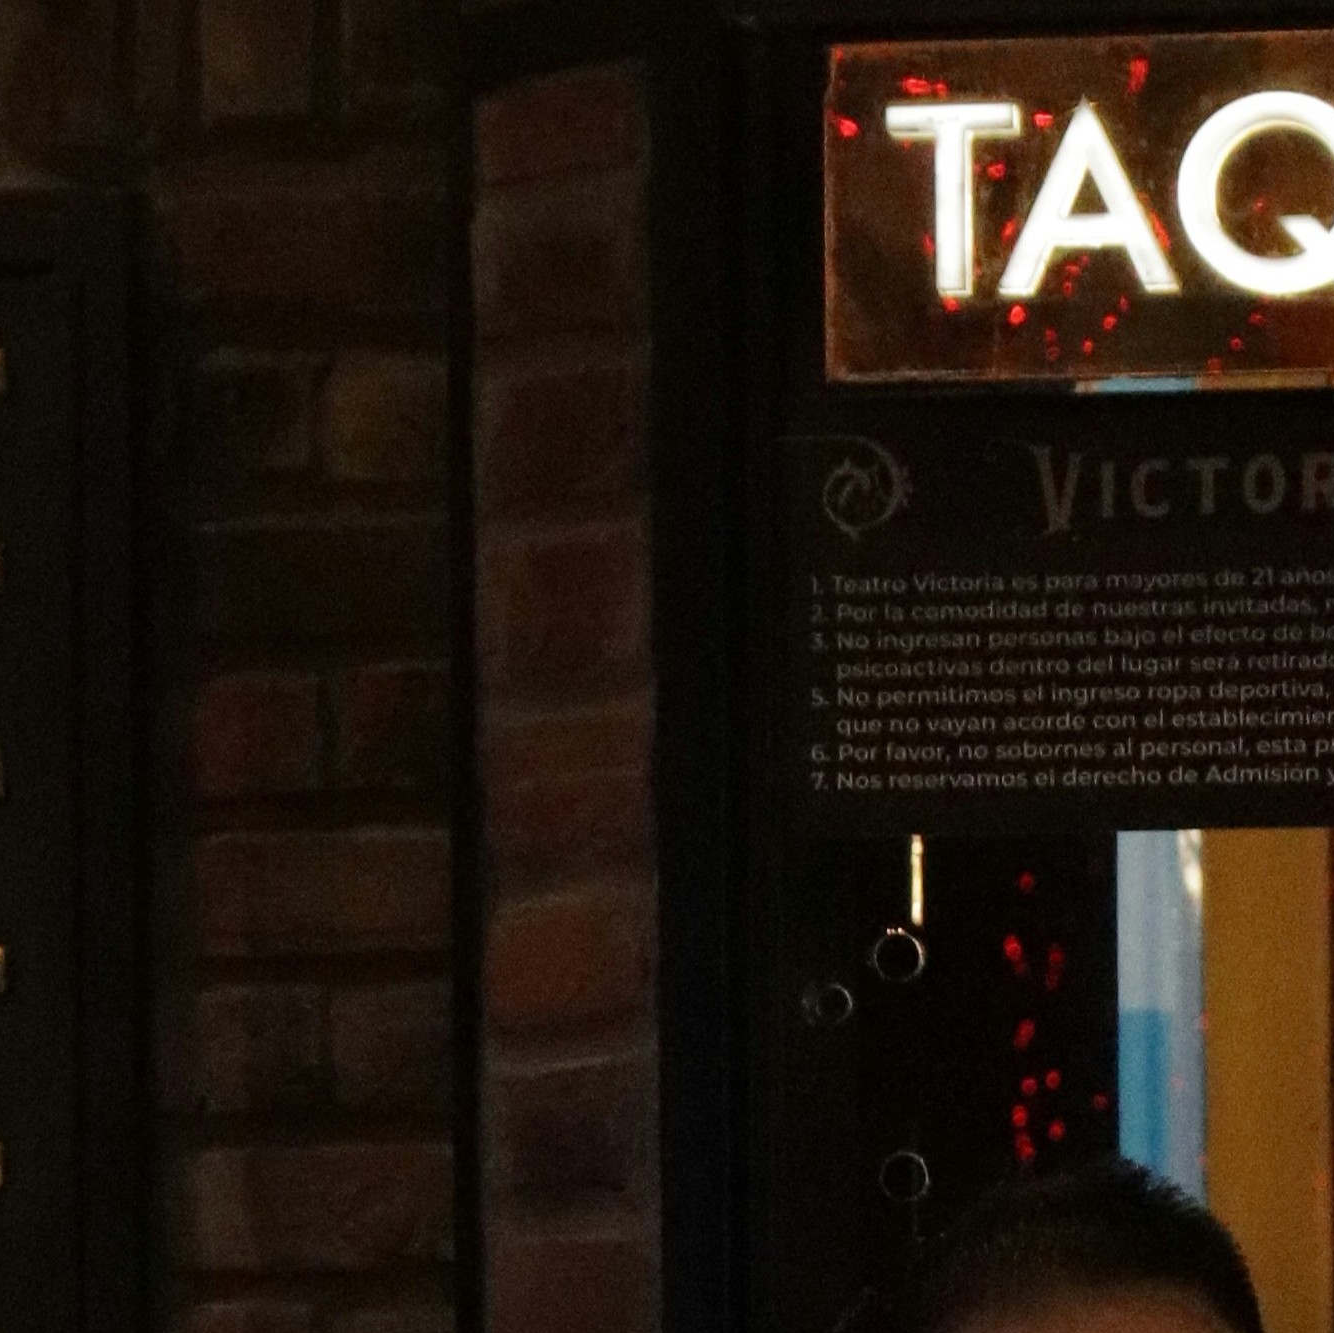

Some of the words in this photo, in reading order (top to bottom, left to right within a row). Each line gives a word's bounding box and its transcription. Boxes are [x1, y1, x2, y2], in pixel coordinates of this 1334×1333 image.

[832, 574, 908, 595] Teatro
[912, 572, 1006, 593] Victoria
[1010, 576, 1039, 591] es
[1043, 574, 1100, 596] para
[1104, 572, 1209, 594] mayores
[1213, 567, 1246, 587] de
[1251, 567, 1275, 586] 21
[834, 603, 878, 623] Por
[883, 602, 906, 622] la
[910, 599, 1049, 621] comodidad
[1053, 599, 1085, 618] de
[1091, 596, 1197, 618] nuestras
[835, 631, 871, 651] No
[875, 629, 982, 655] ingresan
[987, 630, 1098, 653] personas
[1102, 625, 1157, 650] bajo
[1161, 625, 1185, 644] el
[1189, 623, 1267, 643] efecto
[1272, 622, 1304, 642] de
[836, 657, 984, 684] psicoactivas
[988, 655, 1071, 676] dentro
[1075, 654, 1115, 674] del
[1119, 653, 1183, 678] lugar
[809, 688, 830, 708] 5.
[835, 687, 872, 707] No
[875, 684, 1018, 711] permitimos
[1021, 683, 1046, 703] el
[1050, 681, 1142, 707] ingreso
[1145, 684, 1203, 705] ropa
[1207, 677, 1331, 704] deportiva,
[836, 719, 883, 740] que
[887, 718, 921, 734] no
[925, 717, 998, 738] vayan
[1002, 711, 1087, 731] acorde
[1091, 714, 1138, 730] con
[1142, 709, 1166, 728] el
[807, 744, 831, 764] 6.
[836, 743, 880, 763] Por
[884, 741, 952, 767] favor,
[956, 745, 991, 760] no
[994, 738, 1108, 760] sobornes
[1111, 738, 1135, 757] al
[1138, 735, 1251, 762] personal,
[835, 771, 884, 791] Nos
[887, 772, 1029, 790] reservamos
[1032, 767, 1057, 787] el
[1060, 765, 1163, 786] derecho
[1166, 764, 1199, 784] de
